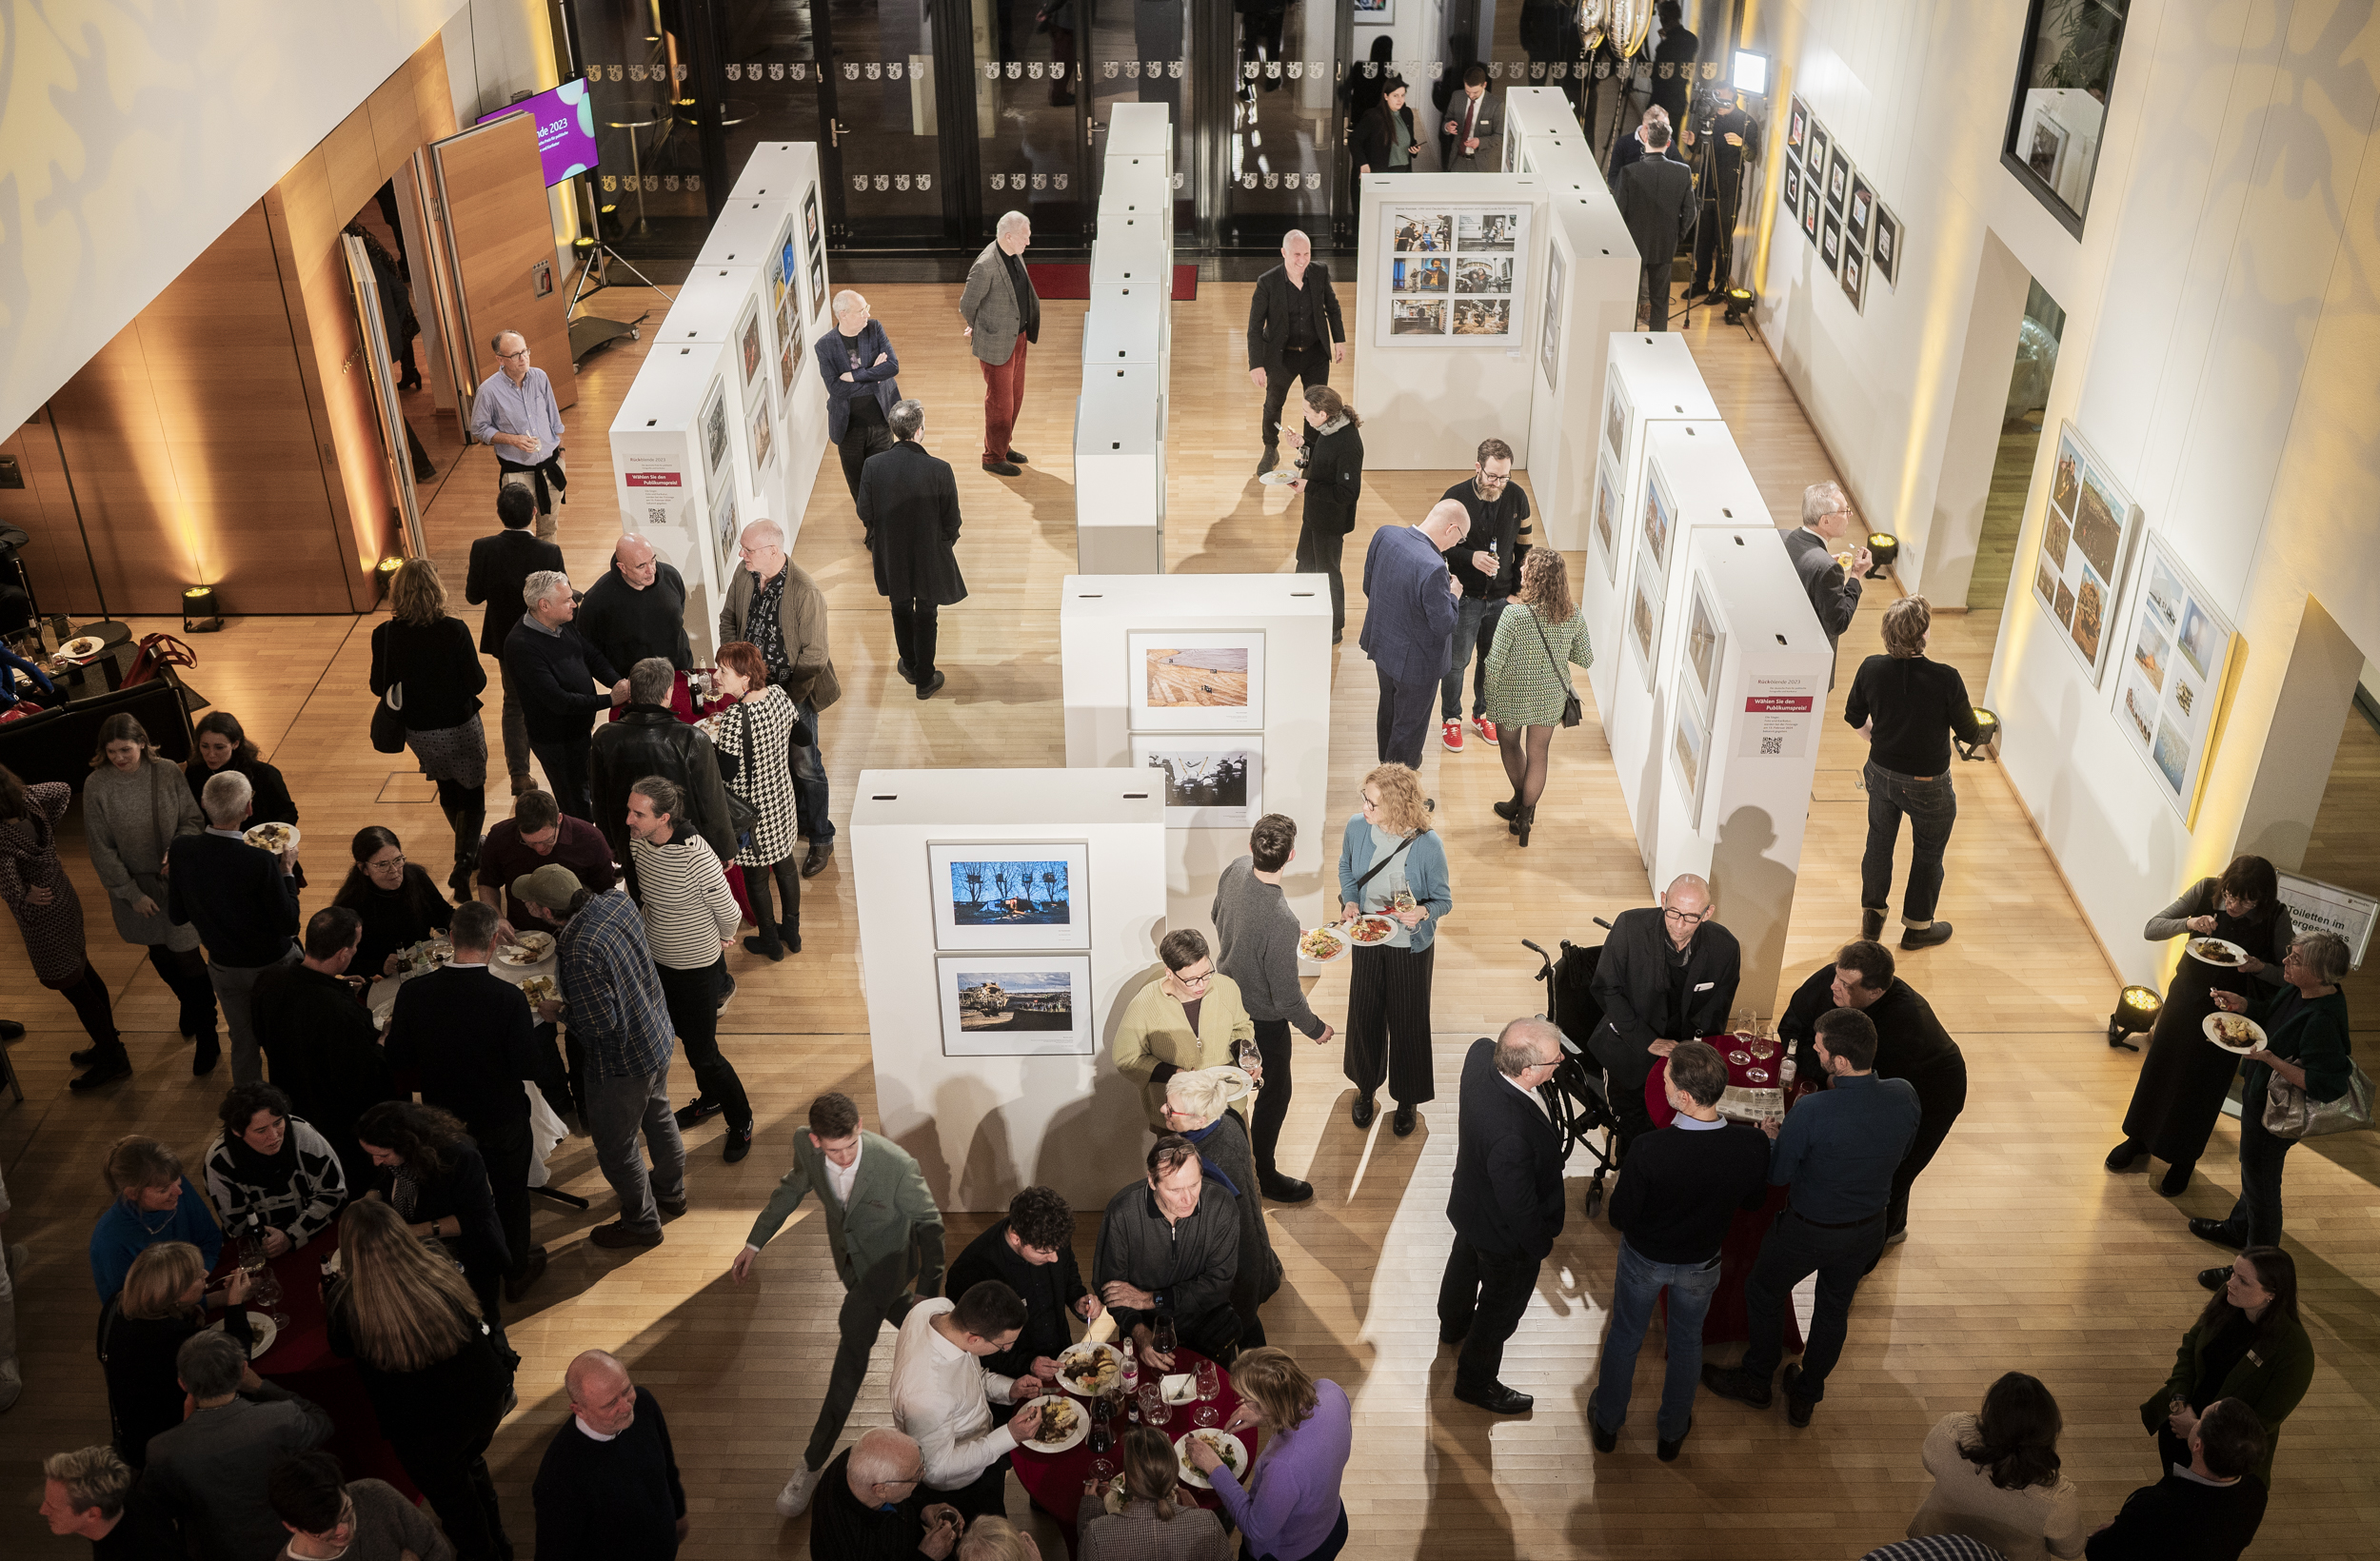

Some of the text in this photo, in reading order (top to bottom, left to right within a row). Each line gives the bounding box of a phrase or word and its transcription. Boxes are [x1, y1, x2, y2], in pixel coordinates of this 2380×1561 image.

[549, 118, 568, 133] 2023
[2288, 905, 2345, 929] Toiletten im
